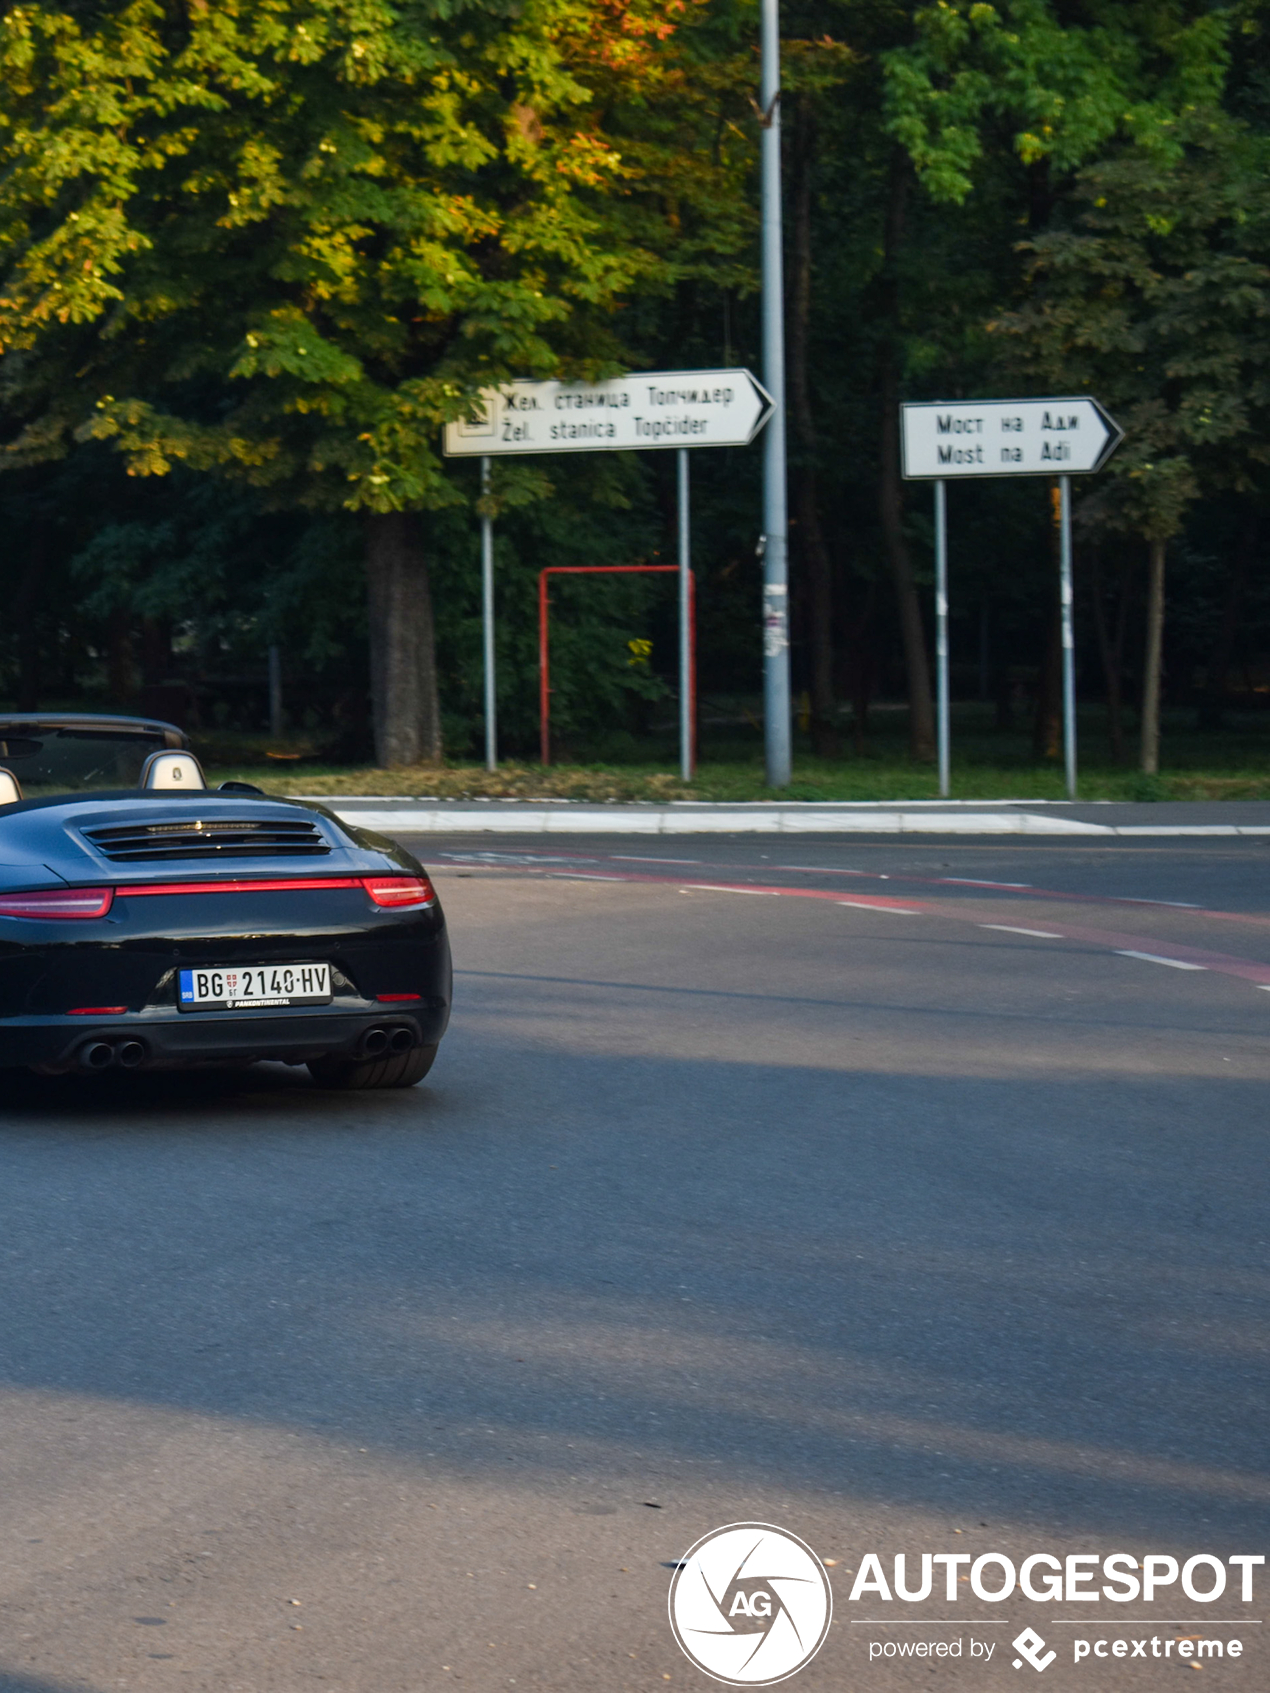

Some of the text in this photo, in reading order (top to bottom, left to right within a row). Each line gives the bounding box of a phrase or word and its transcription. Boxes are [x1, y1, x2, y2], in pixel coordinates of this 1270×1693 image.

[554, 391, 630, 410] станица
[647, 386, 734, 406] Топчидер
[501, 416, 709, 442] Žel. stanica Topčider
[937, 411, 1079, 434] Мост на Ади
[937, 440, 1071, 465] Most na Adi
[196, 973, 223, 998] BG
